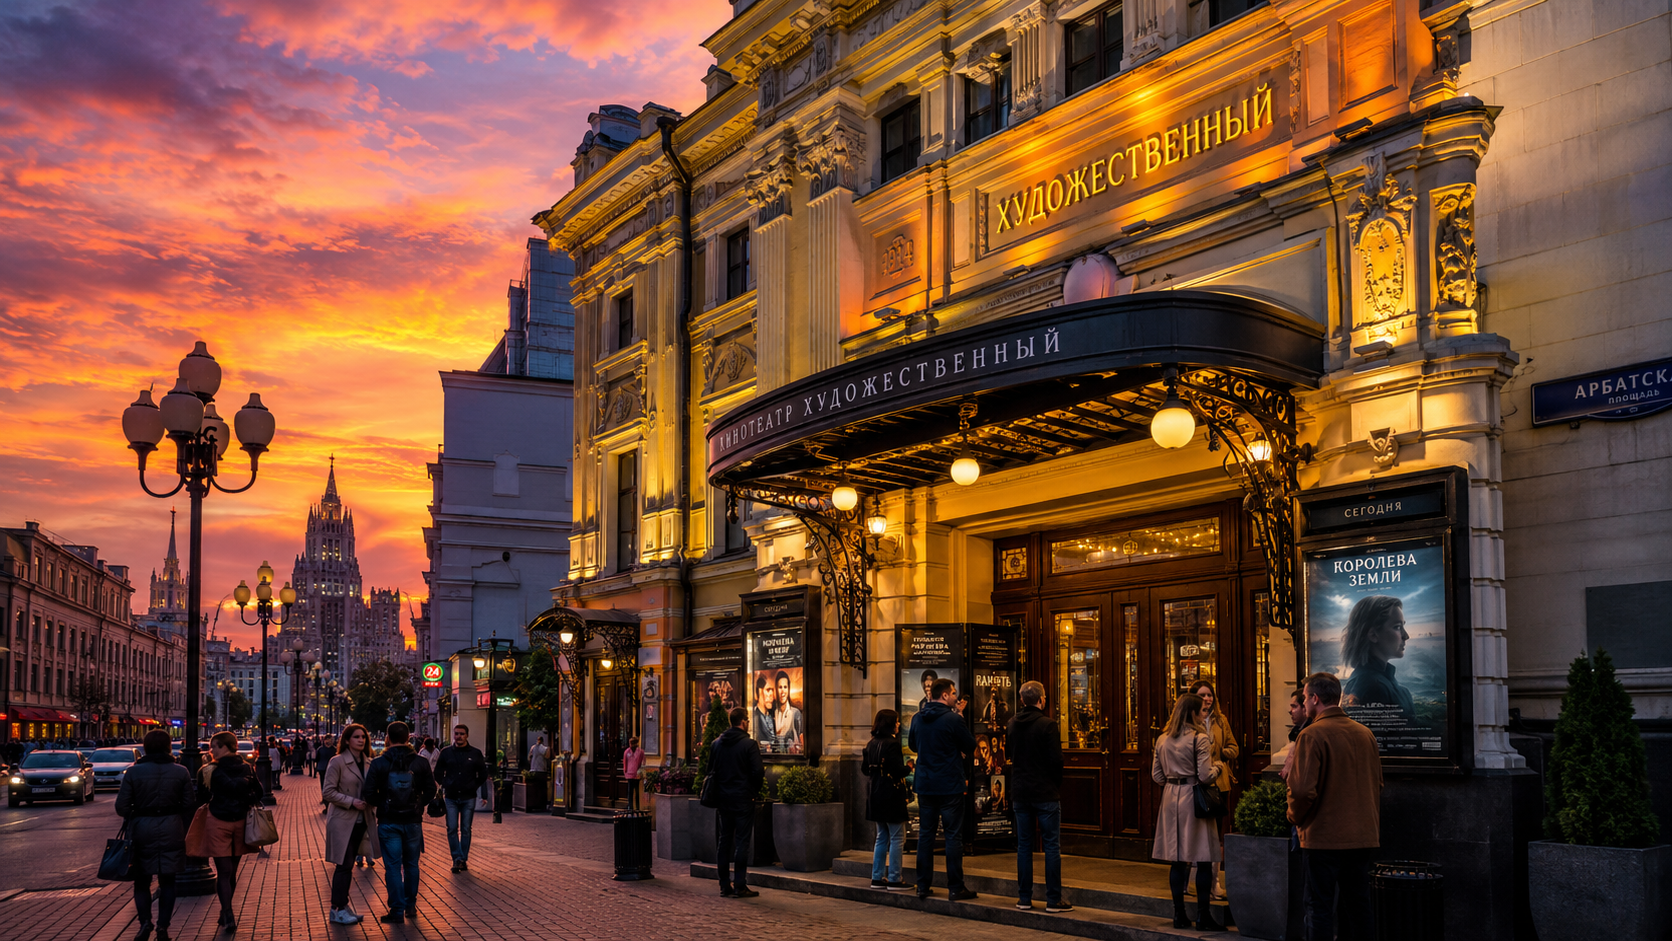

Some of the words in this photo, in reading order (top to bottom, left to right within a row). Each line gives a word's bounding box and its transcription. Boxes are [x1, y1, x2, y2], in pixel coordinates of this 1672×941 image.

[996, 82, 1274, 234] ХУДОЖЕСТВЕННЫЙ
[719, 404, 793, 452] КИНОТЕАТР
[803, 326, 1061, 417] ХУДОЖЕСТВЕННЫЙ
[1344, 501, 1402, 518] СЕГОДНЯ
[1333, 553, 1417, 574] КОРОЛЕВА
[1348, 569, 1401, 587] ЗЕМЛИ
[426, 667, 440, 677] 24
